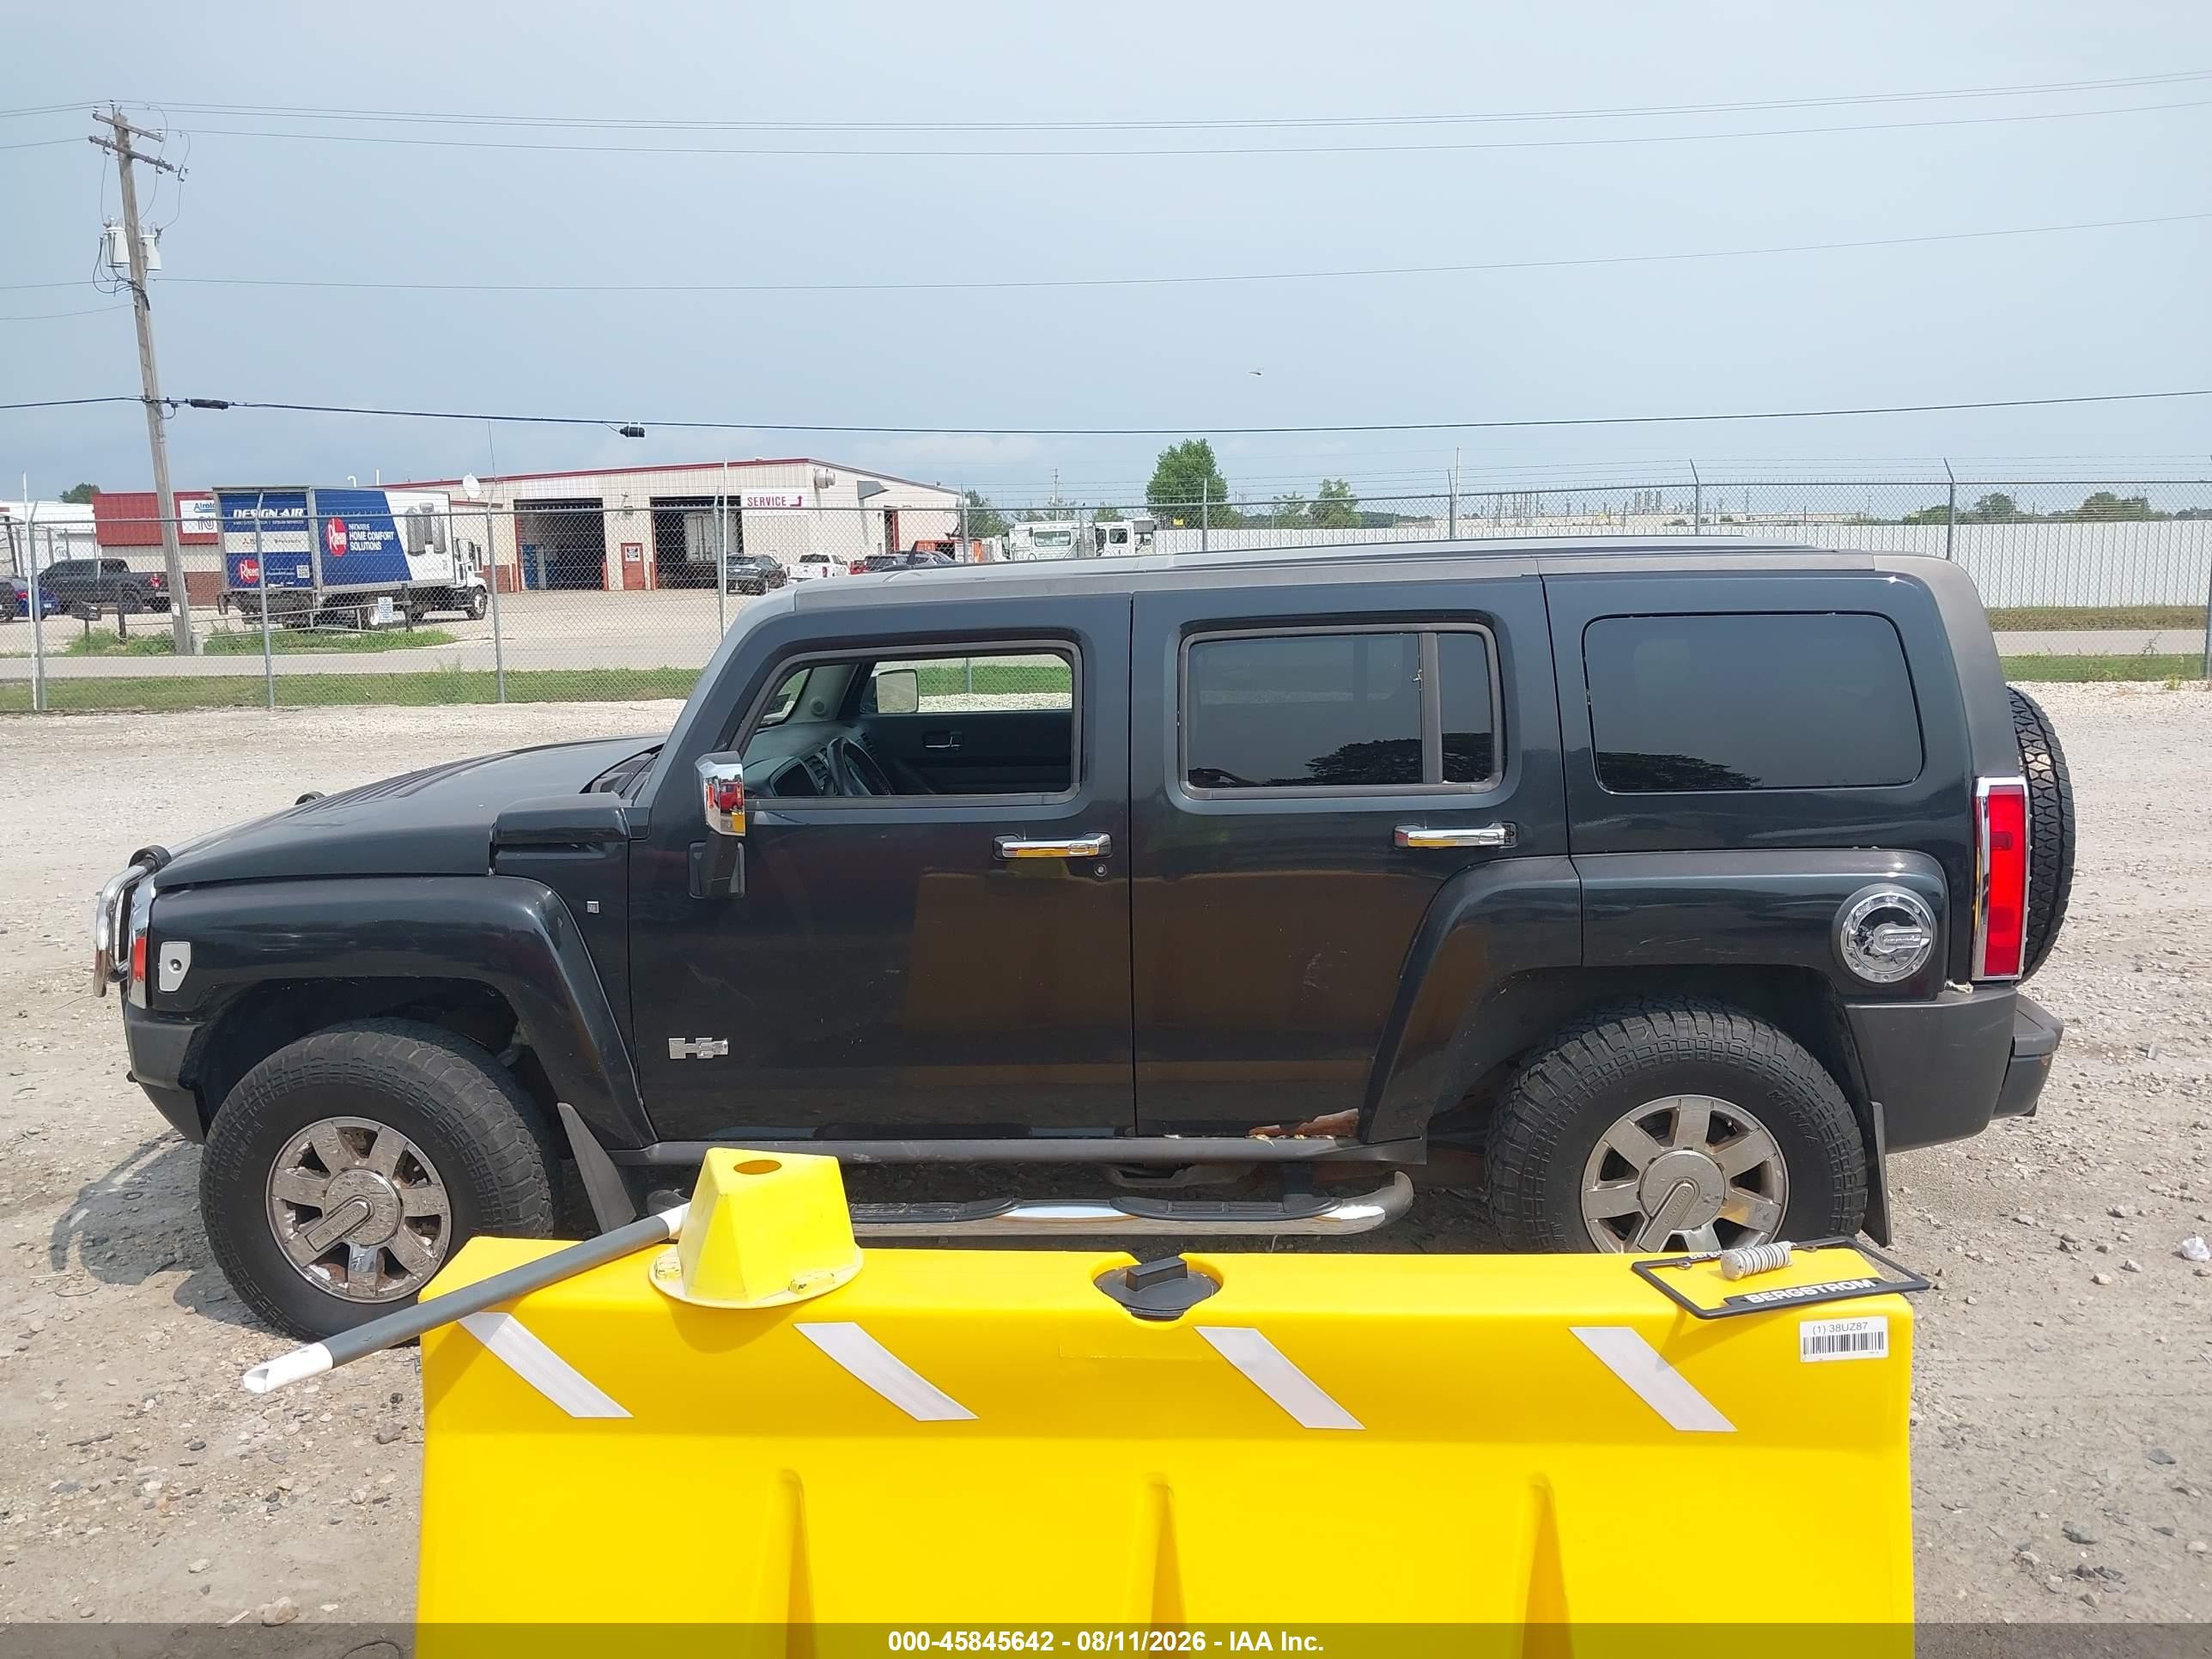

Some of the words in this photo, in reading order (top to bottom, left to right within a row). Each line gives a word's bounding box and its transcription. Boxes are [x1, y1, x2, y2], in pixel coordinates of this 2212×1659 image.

[747, 496, 787, 507] SERVICE
[349, 532, 367, 541] HOME
[368, 531, 394, 541] COMFORT
[350, 541, 381, 551] SOLUTIONS
[1745, 1279, 1876, 1304] BERGSTROM
[1813, 1325, 1826, 1335] (1)
[1829, 1322, 1869, 1333] 38UZ87
